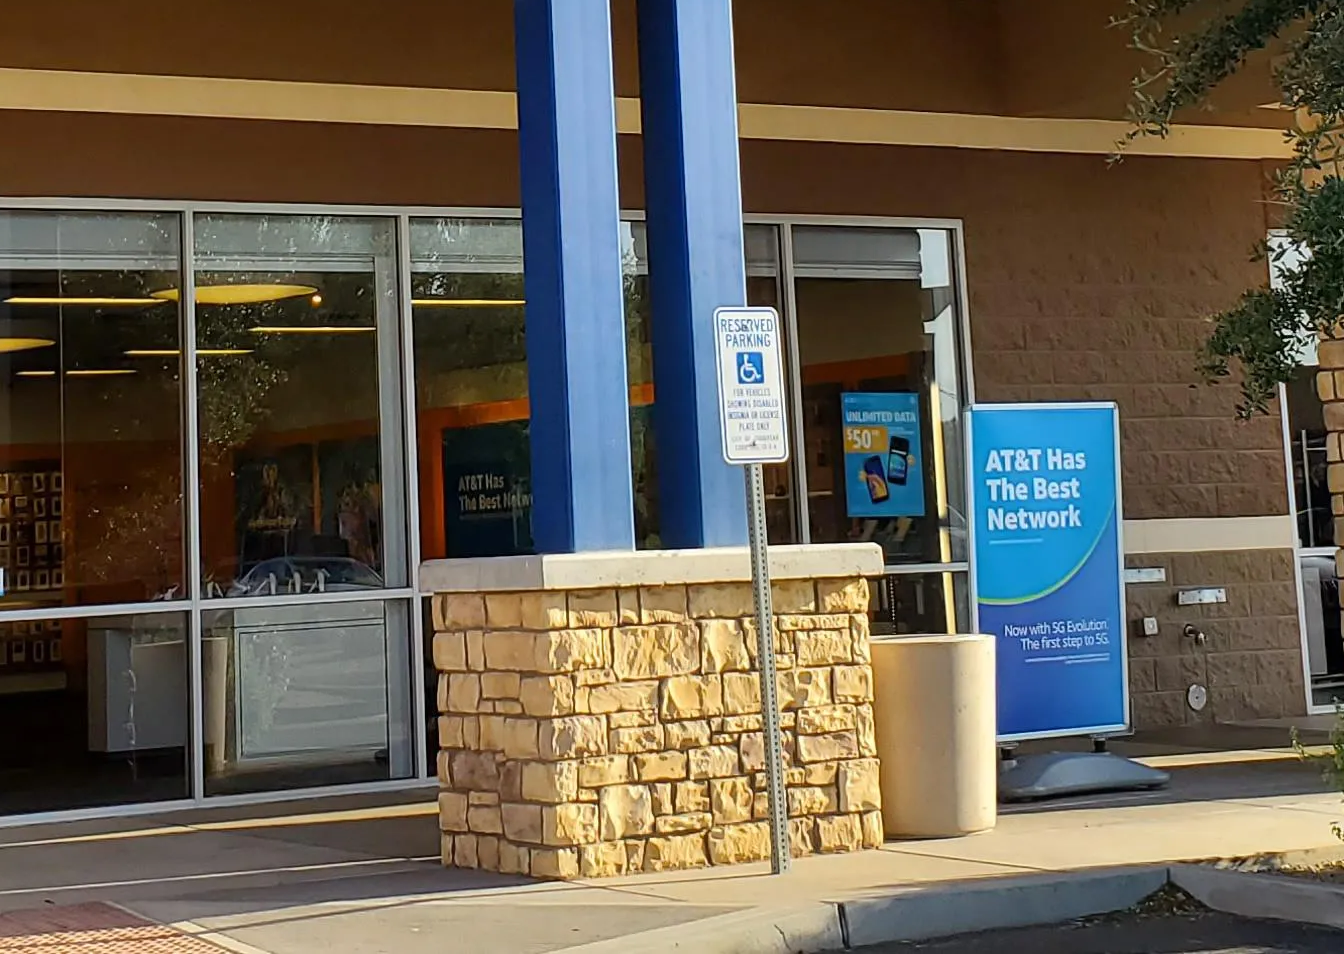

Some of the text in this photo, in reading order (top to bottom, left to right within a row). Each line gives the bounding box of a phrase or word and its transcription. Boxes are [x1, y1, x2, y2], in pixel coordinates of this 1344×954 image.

[720, 318, 773, 332] RESERVED
[725, 333, 771, 348] PARKING
[845, 410, 916, 422] UNLIMITED DATA
[985, 448, 1086, 472] AT&T Has
[458, 473, 504, 492] AT&T Has
[986, 477, 1080, 502] The Best
[459, 494, 477, 511] The
[479, 493, 501, 510] Best
[987, 504, 1082, 531] Network
[1004, 624, 1027, 637] Now
[1029, 622, 1051, 635] with
[1052, 621, 1065, 634] 5G
[1020, 637, 1040, 650] The
[1041, 636, 1061, 649] first
[1062, 636, 1083, 649] step
[1084, 635, 1094, 646] to
